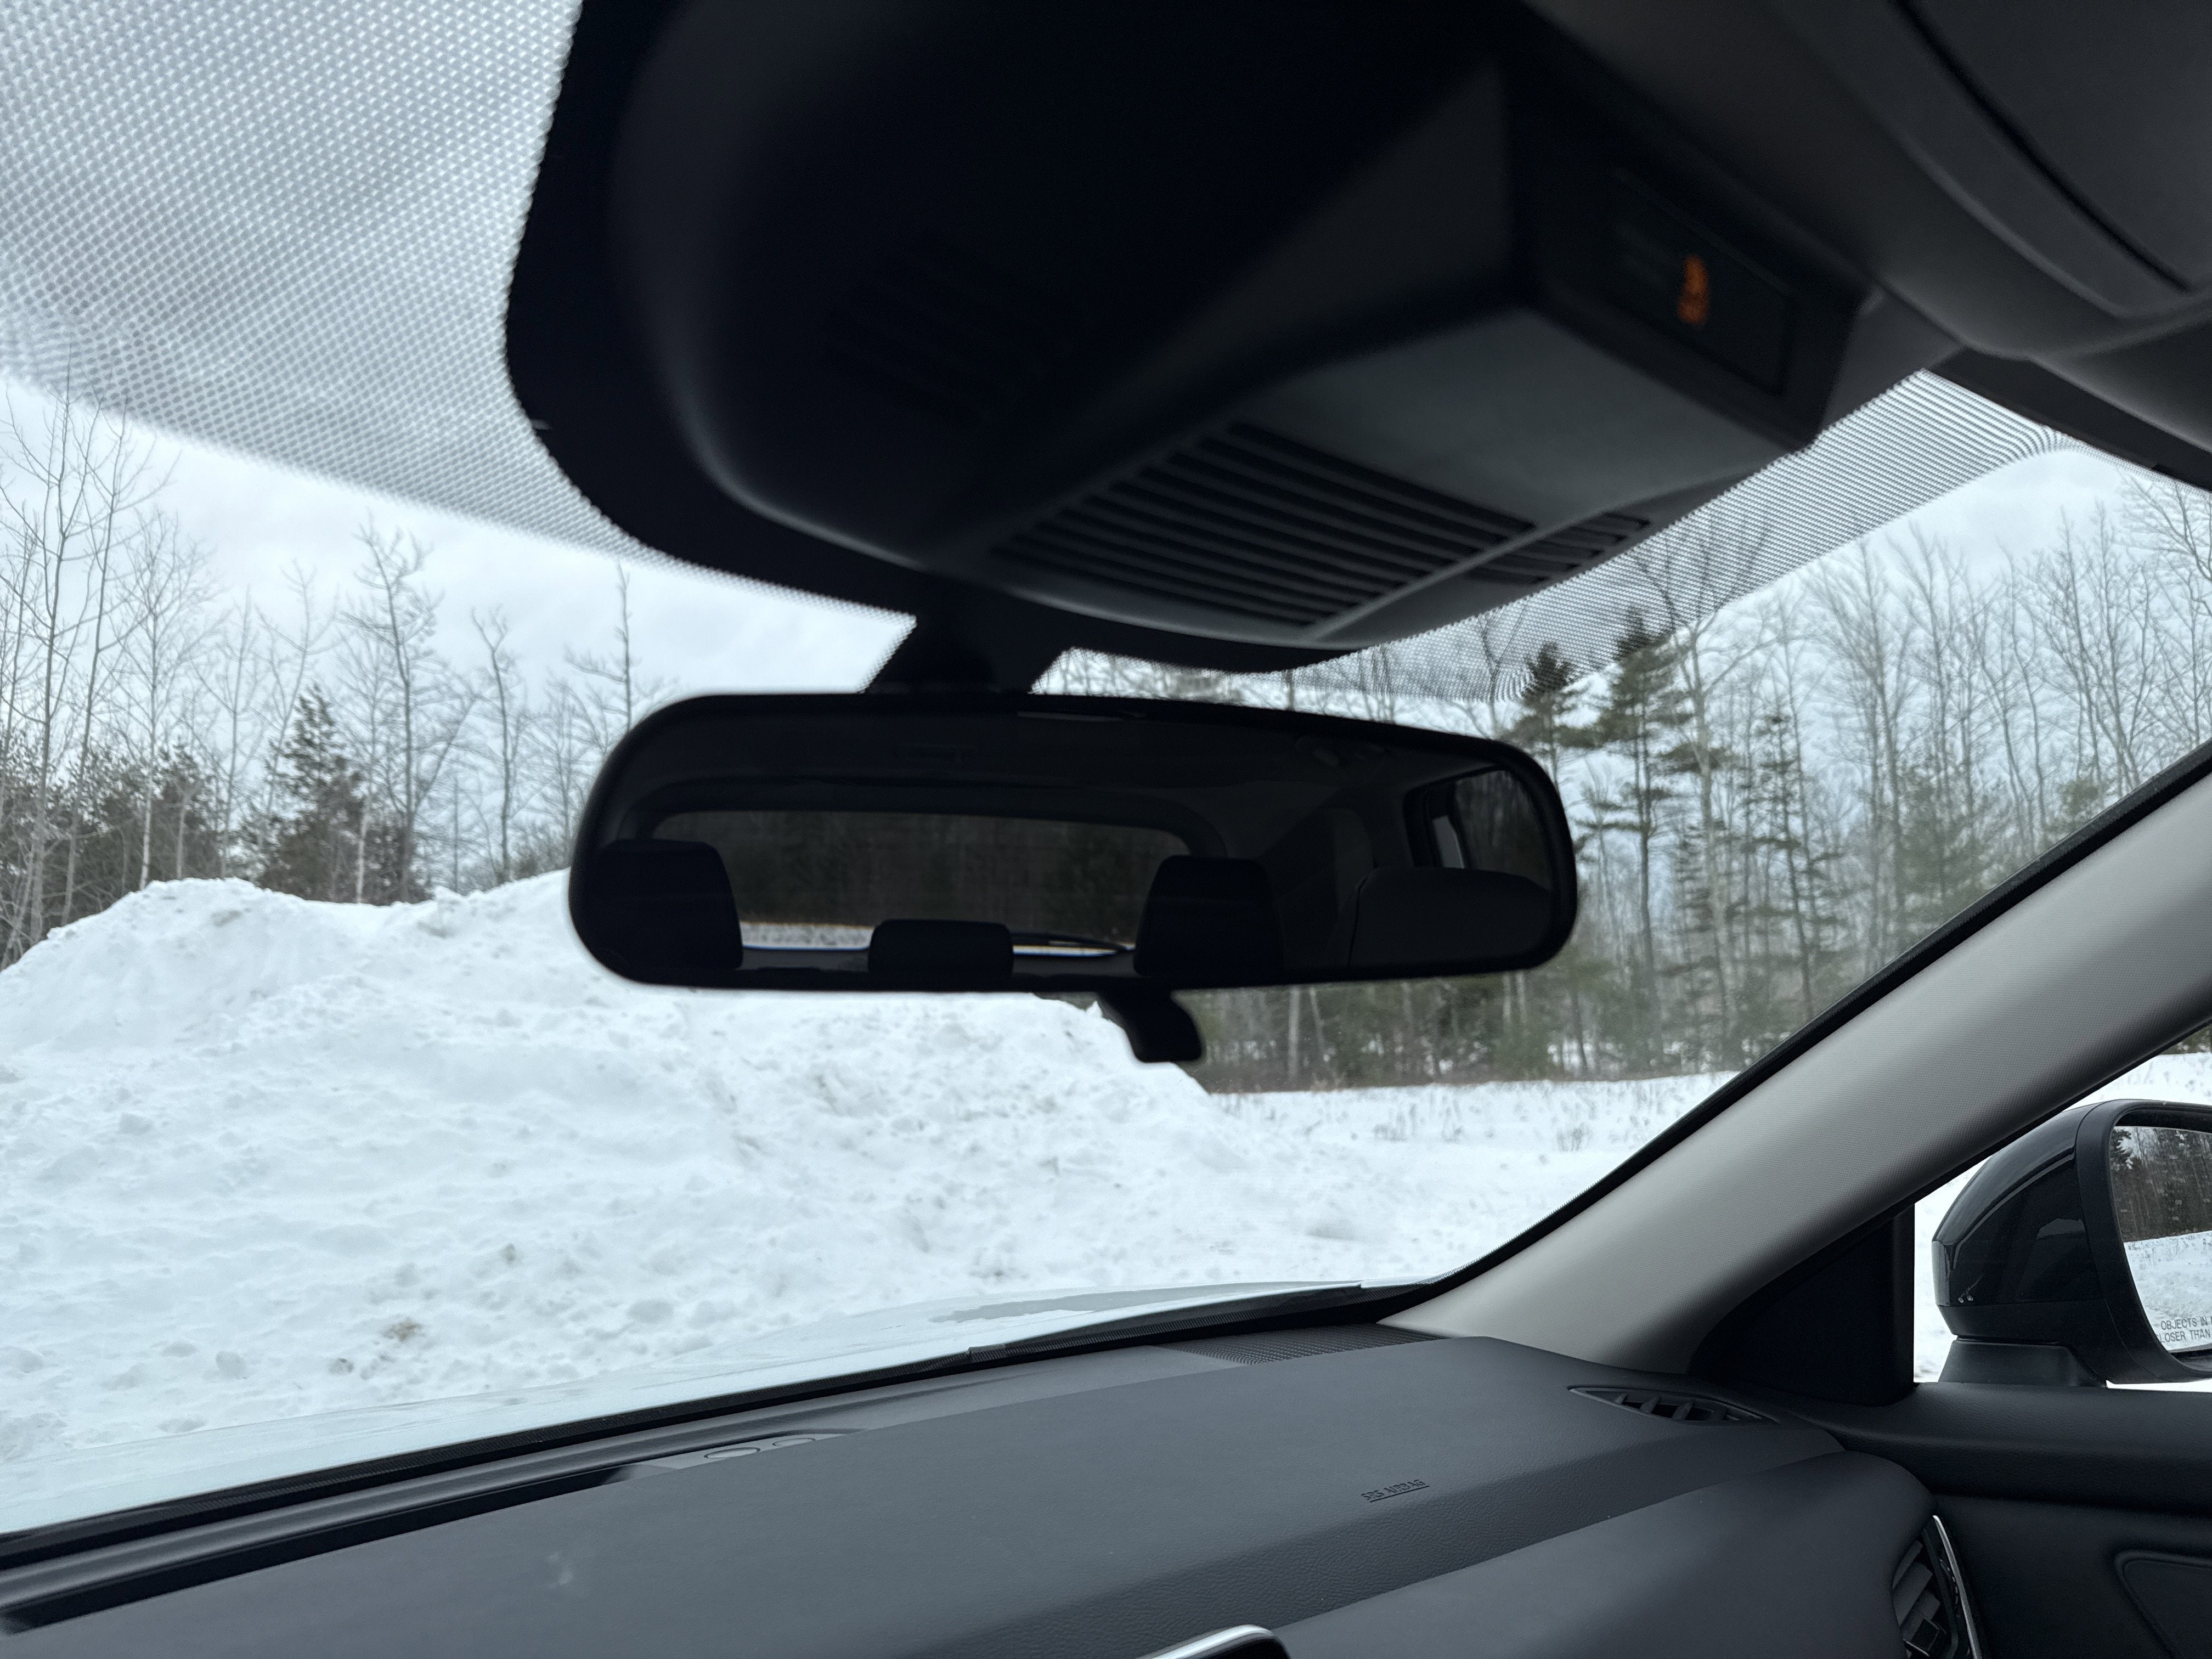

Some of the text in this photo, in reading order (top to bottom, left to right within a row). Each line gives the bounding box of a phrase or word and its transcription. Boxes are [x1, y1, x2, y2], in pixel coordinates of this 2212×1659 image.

[2160, 1318, 2197, 1330] OBJECTS
[2200, 1317, 2208, 1326] IN
[2189, 1329, 2211, 1340] THAN
[1361, 1480, 1426, 1500] SRS AIRBAG
